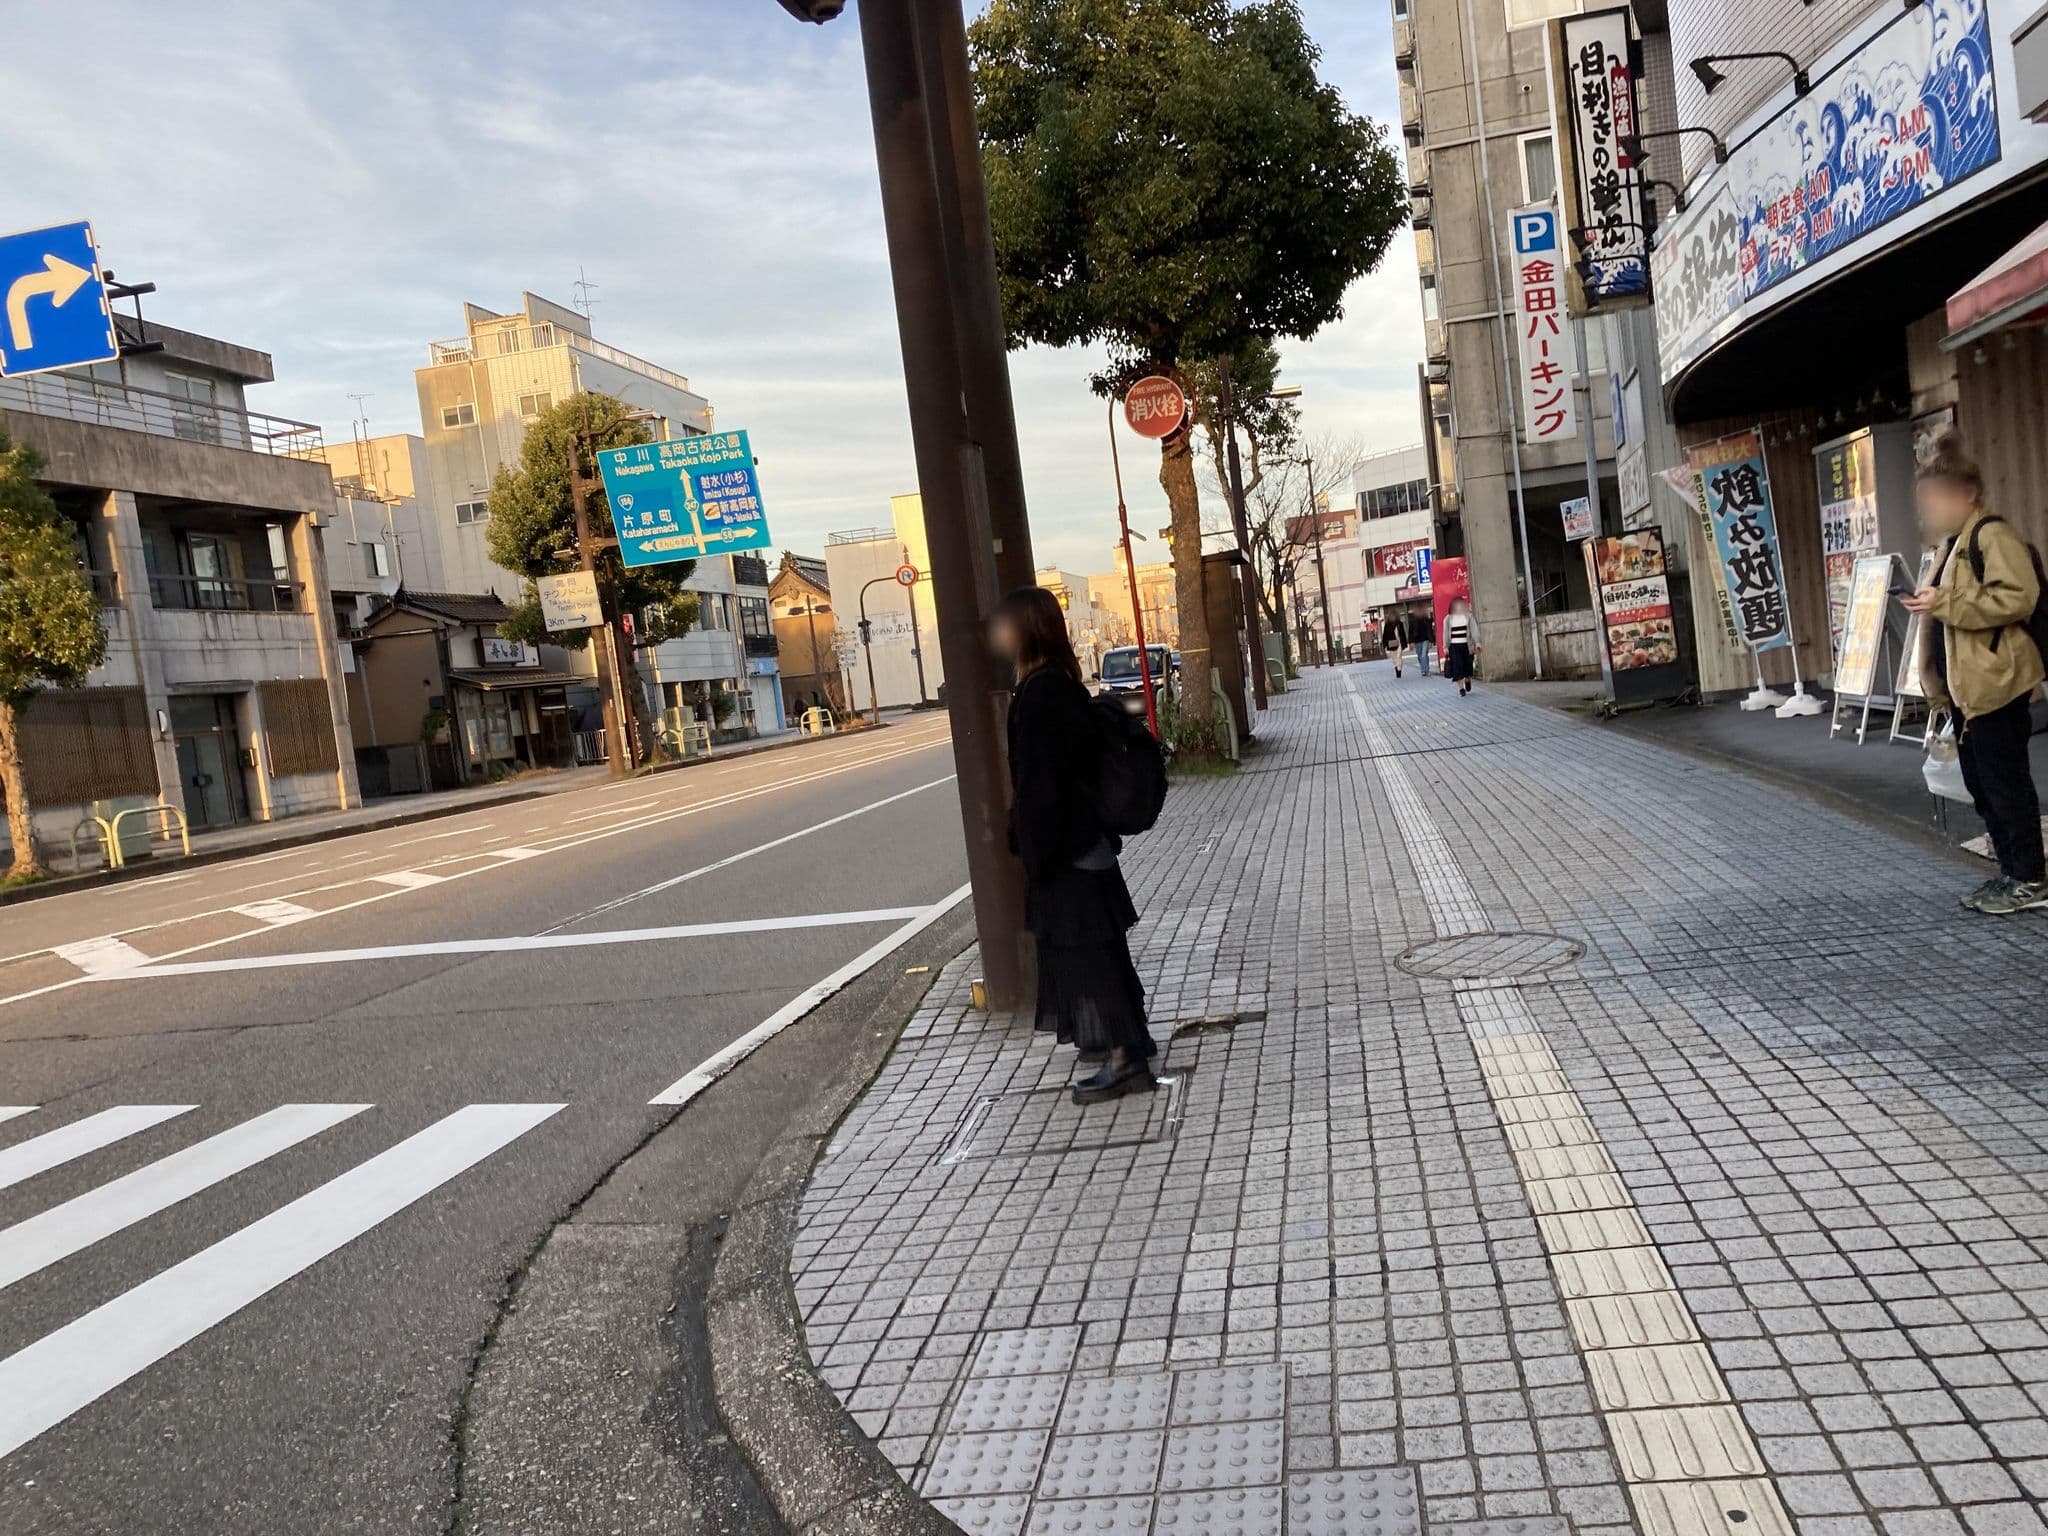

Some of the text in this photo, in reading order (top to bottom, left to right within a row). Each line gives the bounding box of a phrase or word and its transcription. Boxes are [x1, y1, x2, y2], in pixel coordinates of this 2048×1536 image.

[1613, 76, 1631, 156] 漁港直
[1766, 186, 1806, 231] 朝定食
[1770, 223, 1808, 265] ランチ
[1902, 148, 1930, 187] PM
[1520, 217, 1548, 249] P
[1521, 259, 1567, 436] 金田パーキング
[1131, 393, 1179, 422] 消火栓
[614, 449, 650, 465] 中川
[659, 434, 740, 458] 高岡古城公園
[615, 463, 655, 477] Nakagawa
[659, 449, 744, 470] Takaoka Kojo Park
[720, 497, 758, 513] 新高岡駅
[623, 509, 671, 527] 片原町
[622, 522, 678, 538] Kataharamachi
[544, 586, 593, 600] テクノドーム
